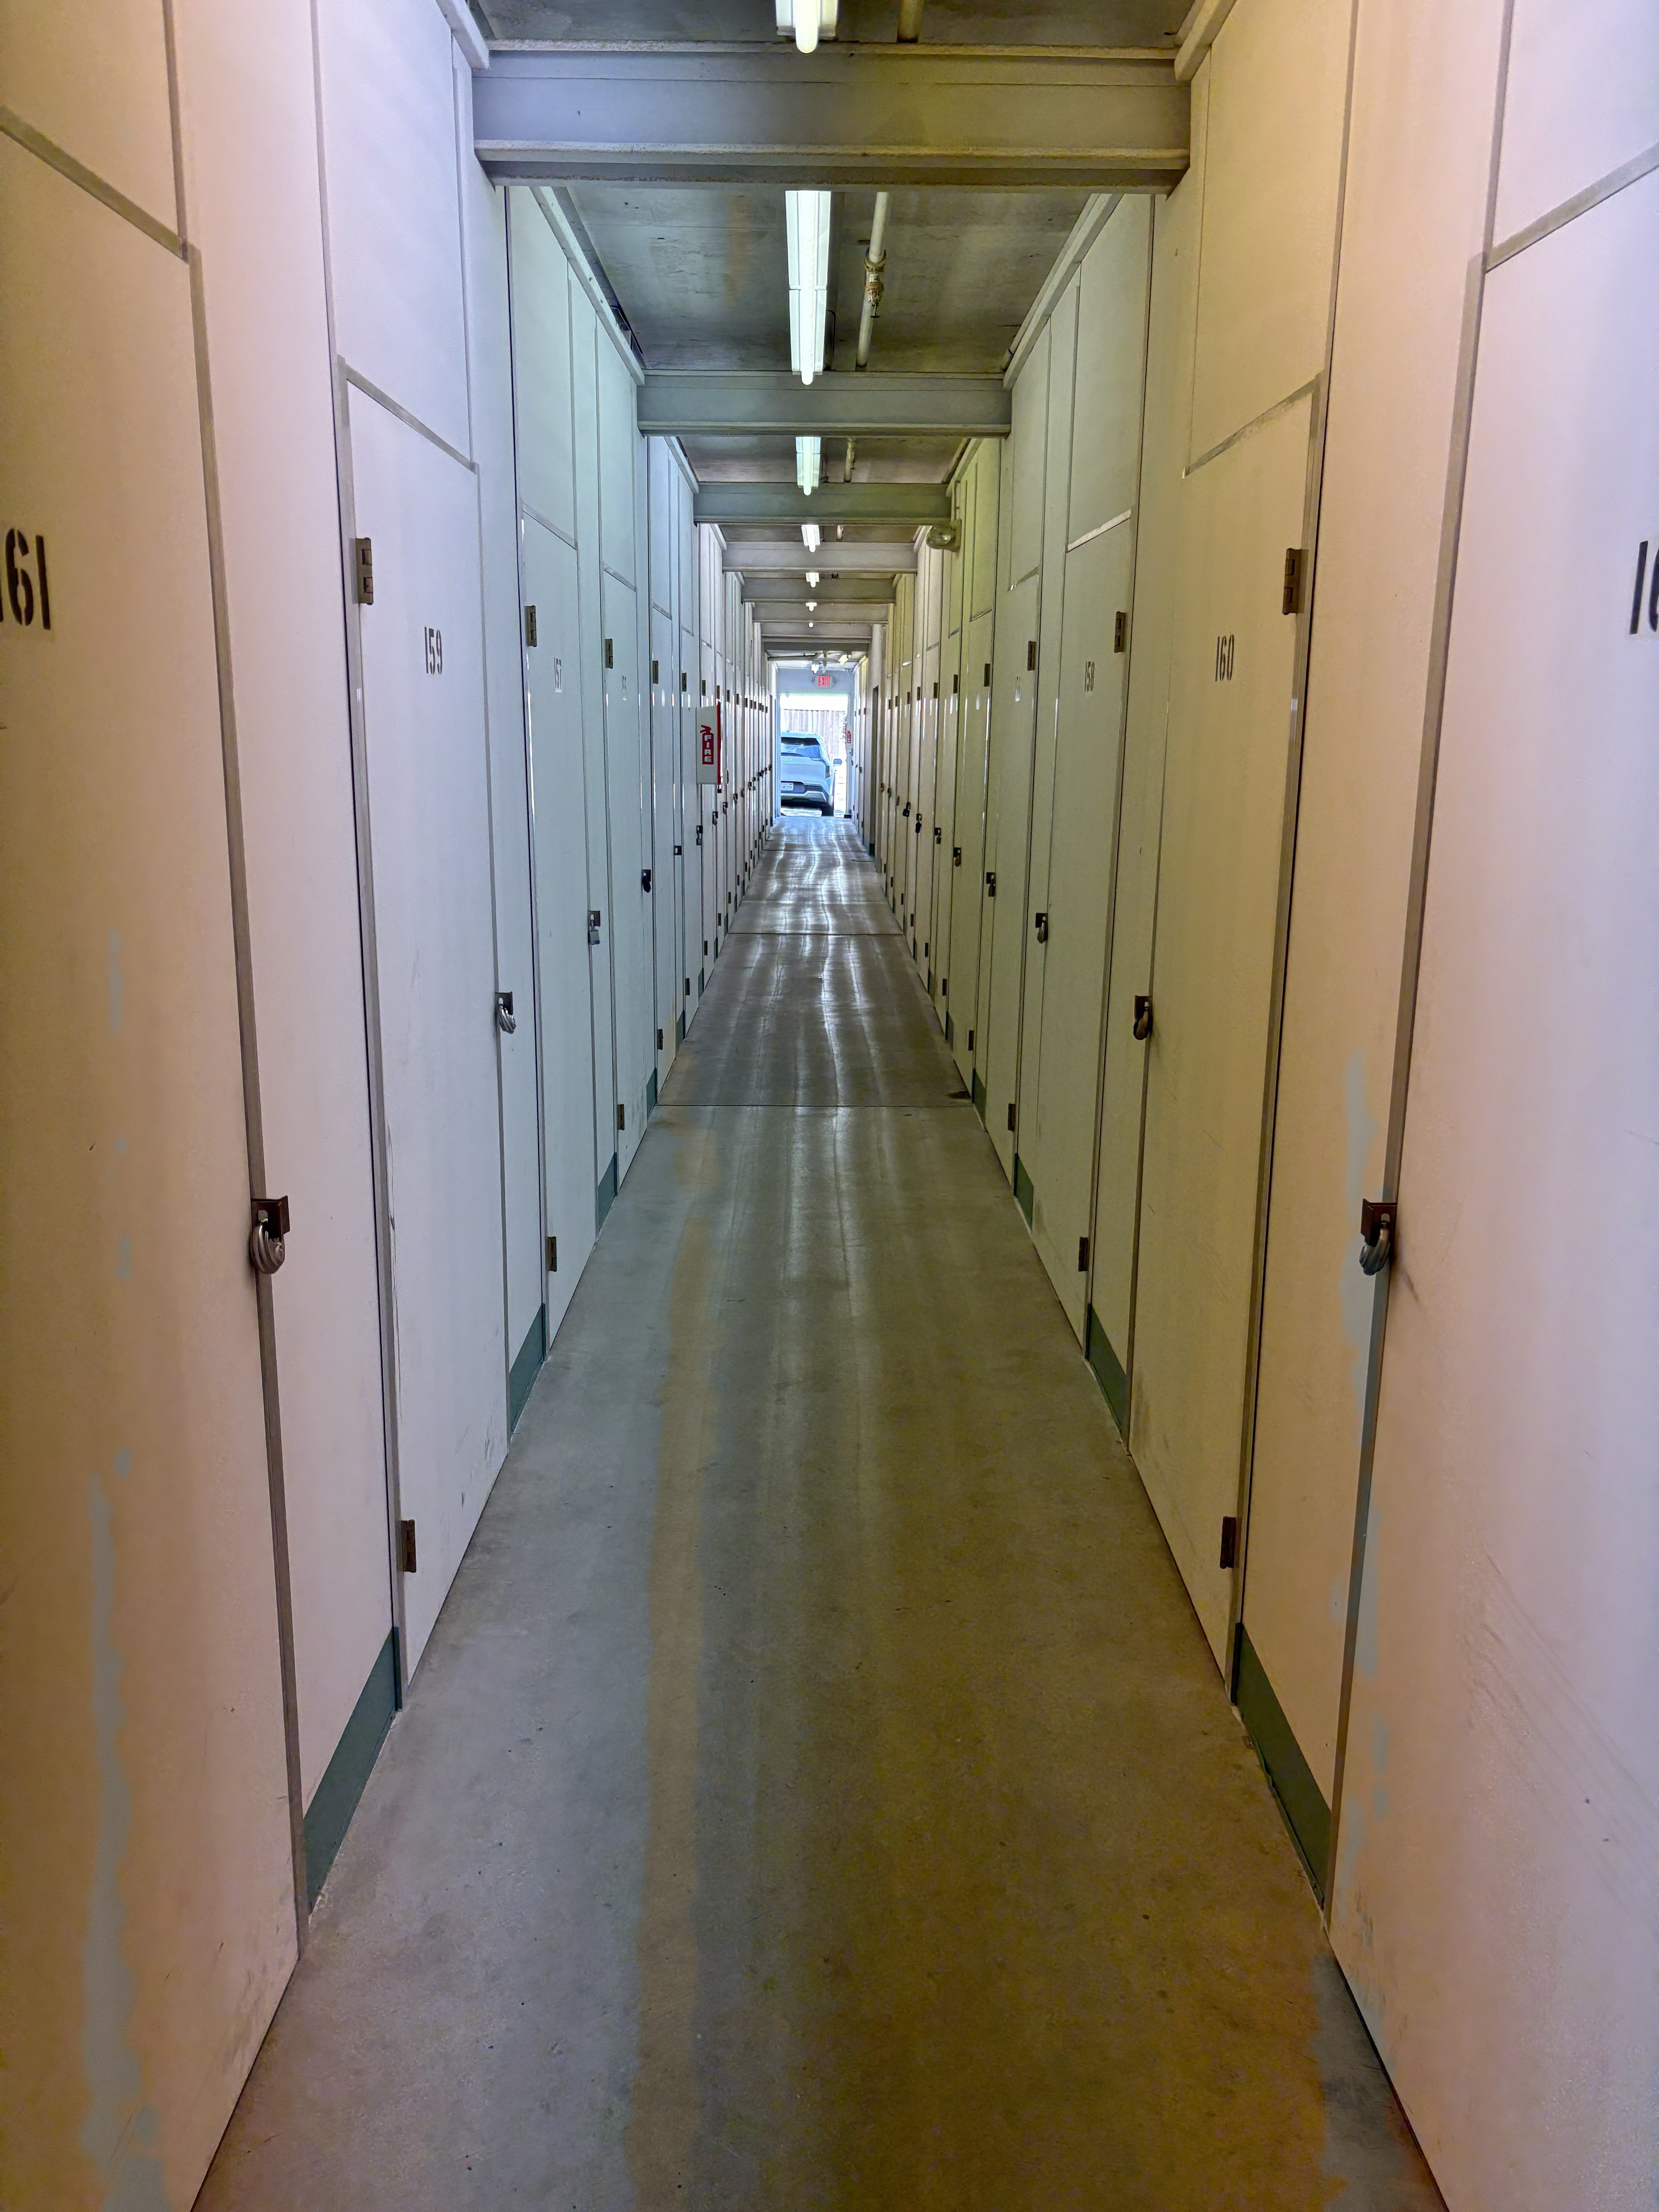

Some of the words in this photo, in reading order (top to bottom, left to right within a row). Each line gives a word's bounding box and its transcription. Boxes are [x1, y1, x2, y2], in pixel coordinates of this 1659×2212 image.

[424, 626, 442, 675] 159
[1215, 634, 1234, 682] 160
[817, 676, 830, 687] EXIT
[1085, 661, 1094, 692] 158
